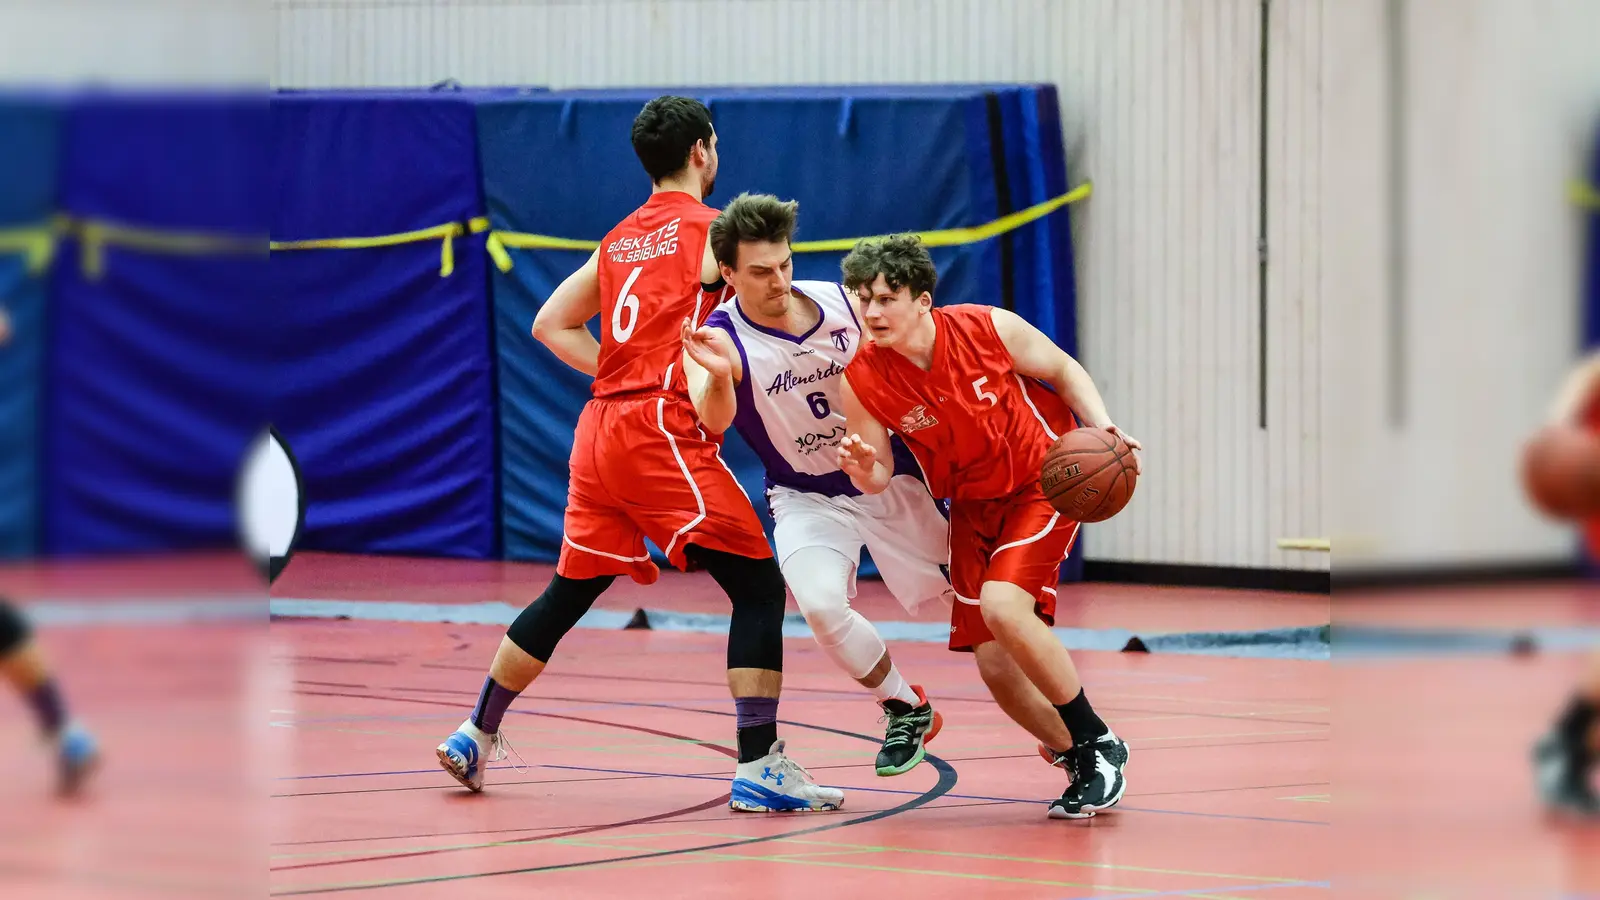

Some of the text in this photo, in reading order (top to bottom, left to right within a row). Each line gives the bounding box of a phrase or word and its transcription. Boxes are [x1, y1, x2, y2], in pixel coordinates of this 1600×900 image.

[611, 266, 643, 343] 6
[805, 391, 831, 420] 6
[971, 375, 998, 407] 5
